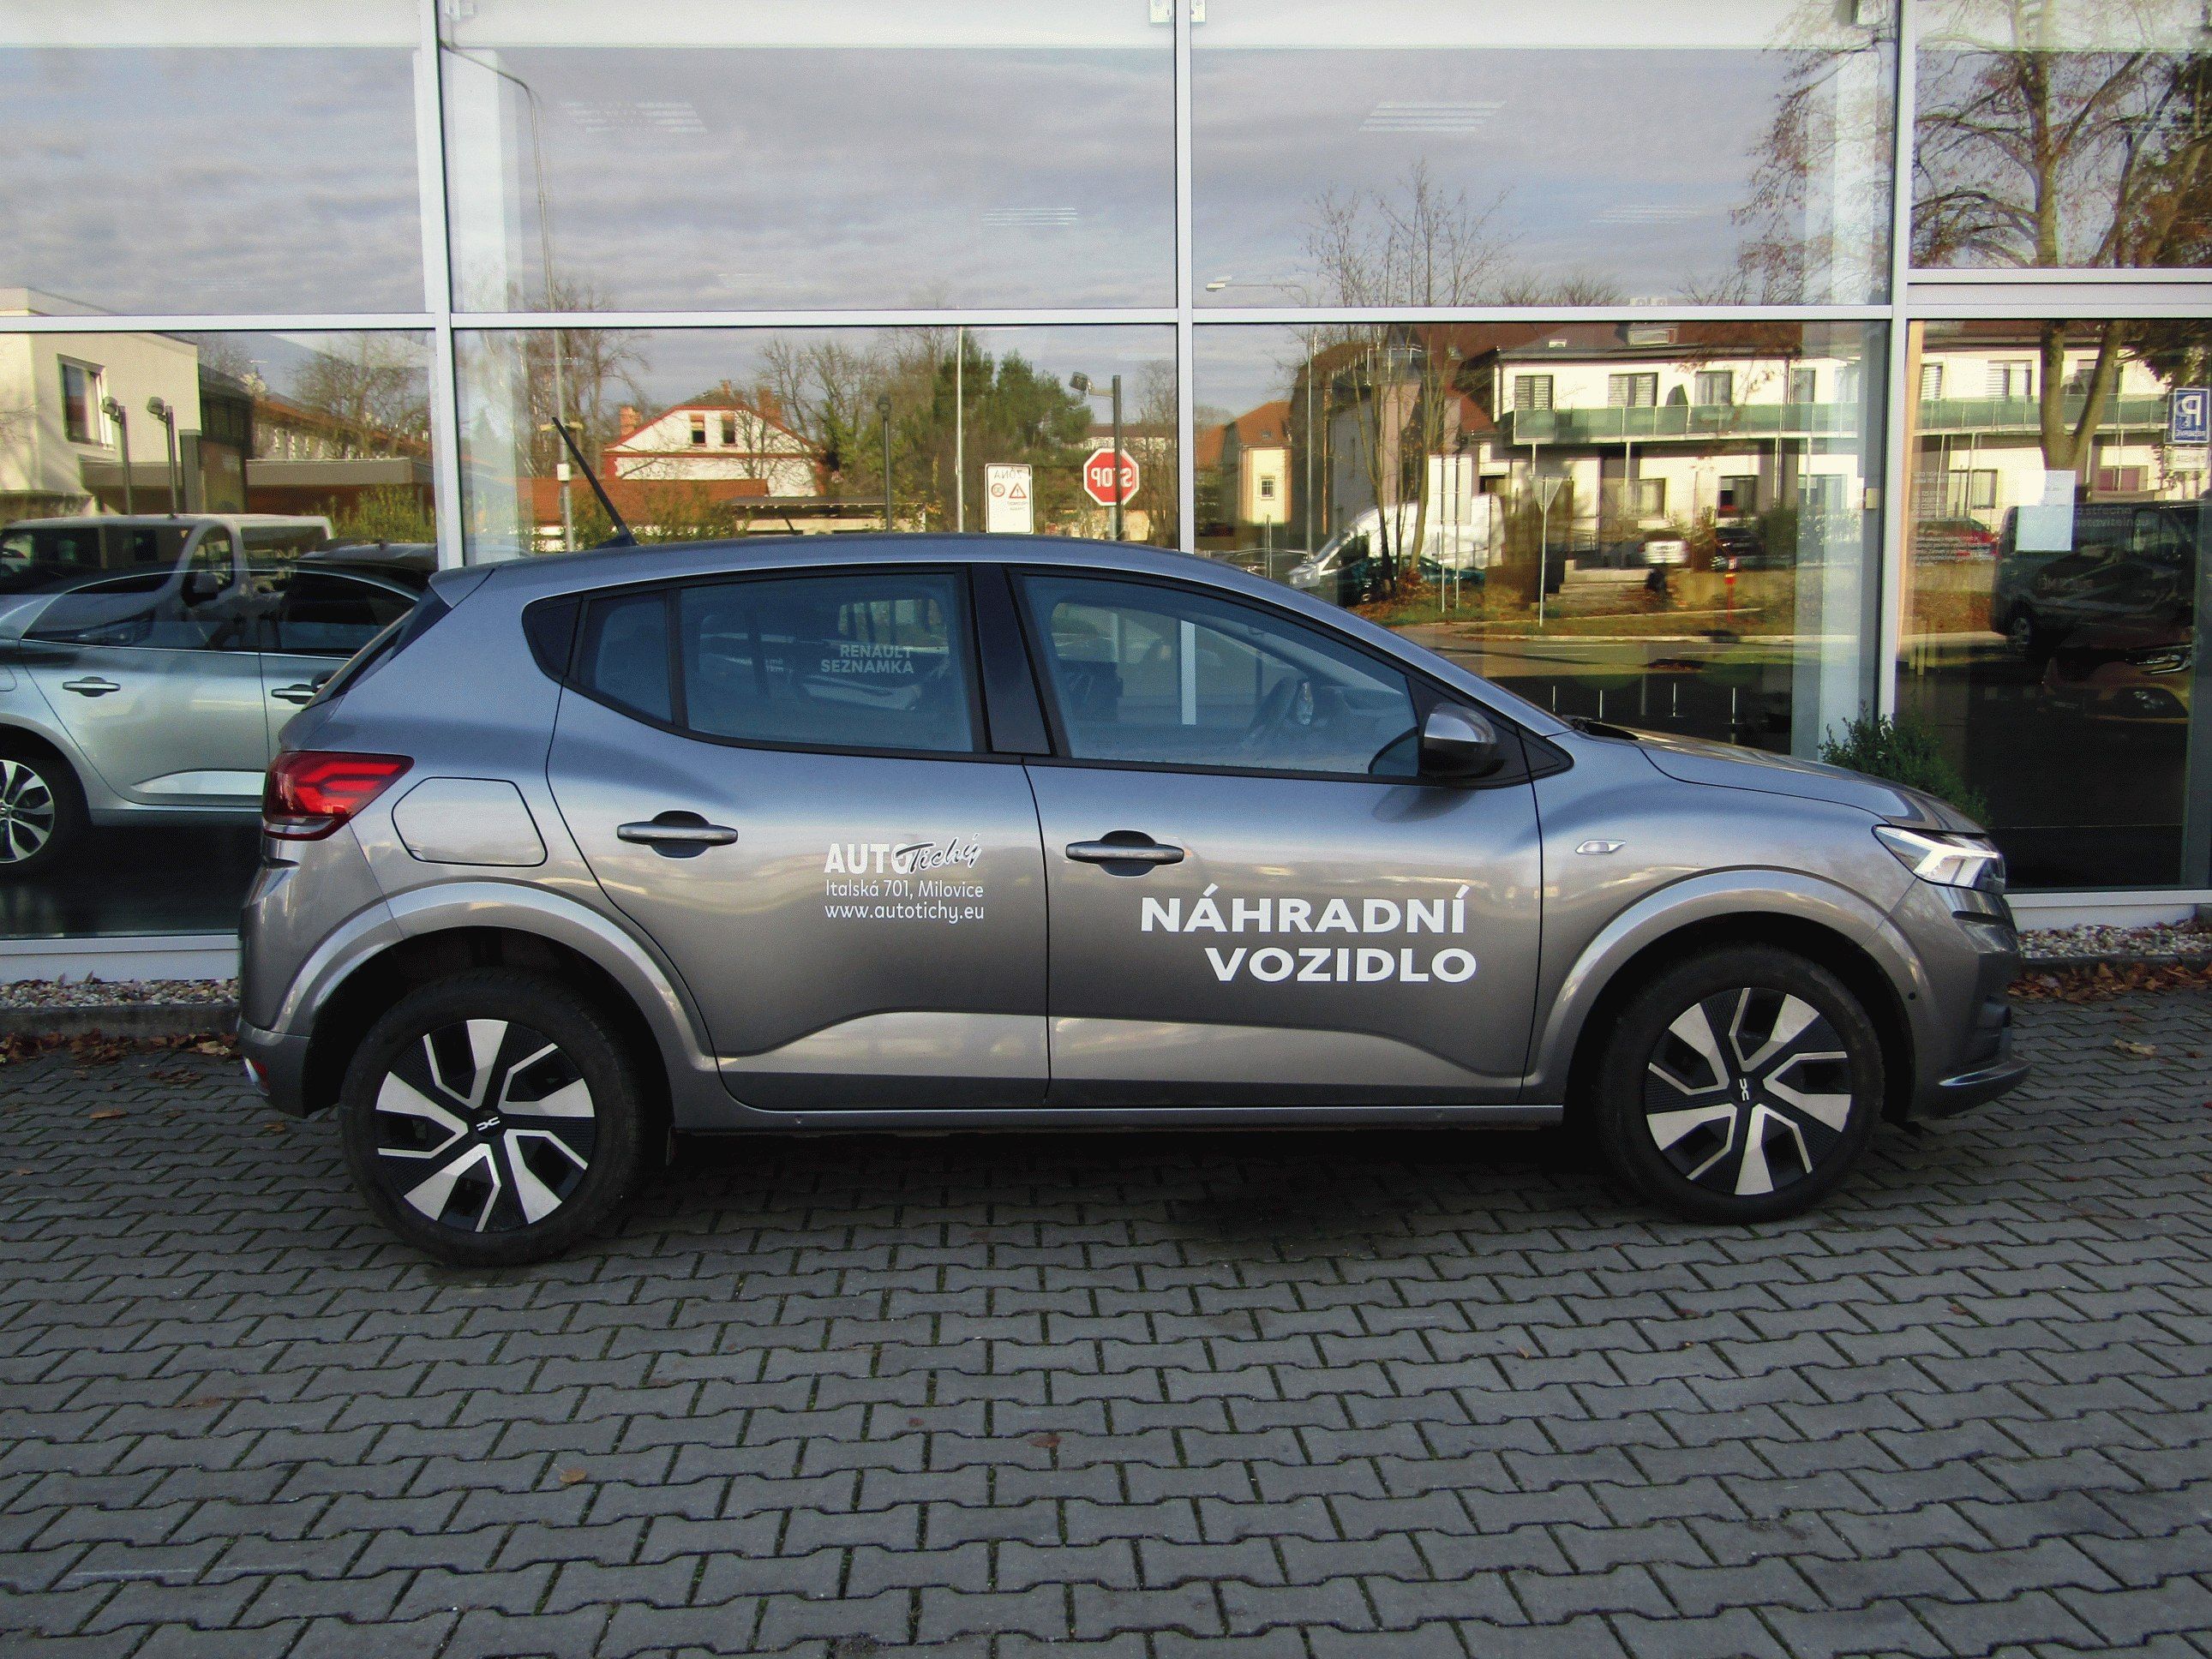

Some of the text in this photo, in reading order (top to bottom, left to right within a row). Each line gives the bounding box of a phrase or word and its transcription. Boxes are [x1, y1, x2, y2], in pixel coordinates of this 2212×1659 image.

[840, 644, 912, 659] RENAULT
[820, 659, 914, 674] SEZNAMKA
[894, 833, 983, 874] Tichý
[825, 879, 984, 901] Italská 701, Milovice
[824, 901, 984, 925] www.autotichy.eu
[1141, 883, 1470, 933] NÁHRADNÍ
[1205, 947, 1477, 983] VOZIDLO
